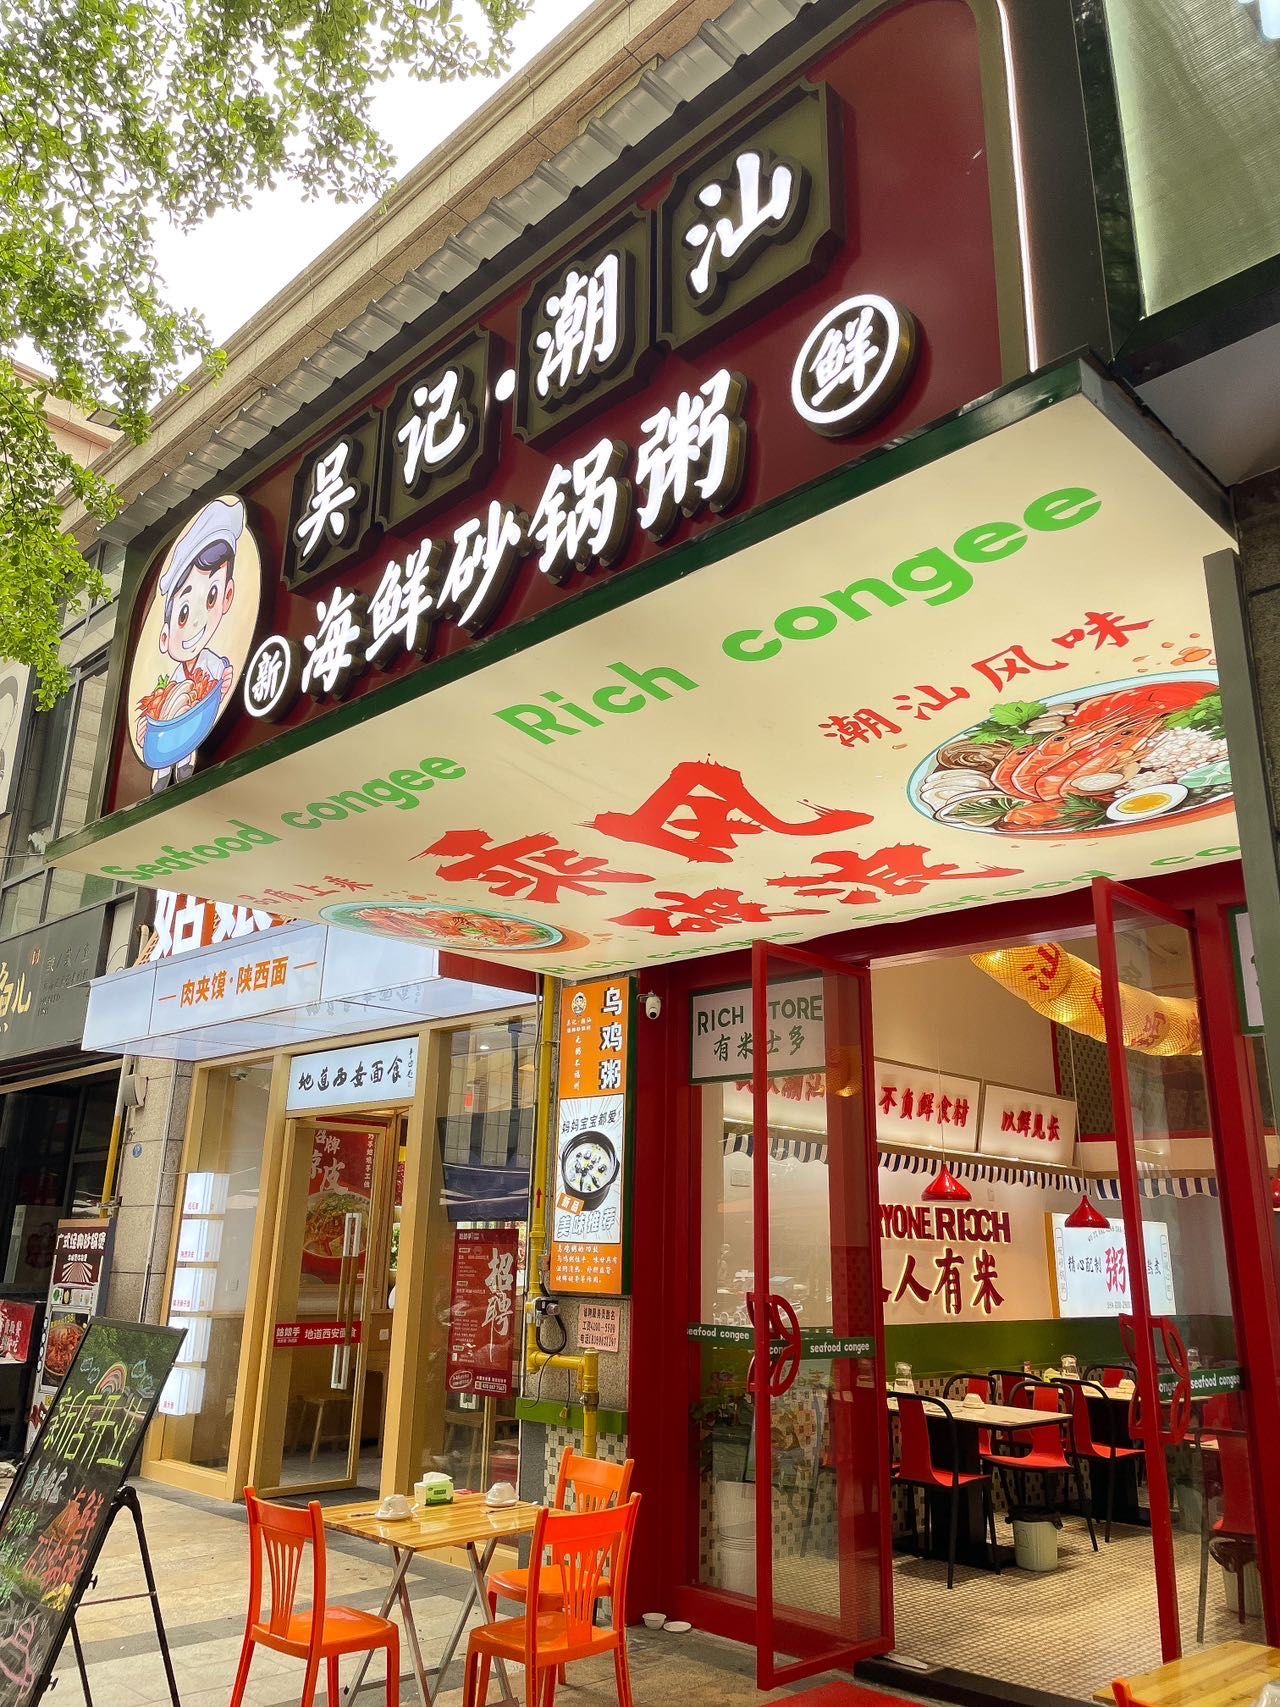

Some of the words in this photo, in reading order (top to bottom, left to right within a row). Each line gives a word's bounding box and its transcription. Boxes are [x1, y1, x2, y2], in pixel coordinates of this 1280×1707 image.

[301, 369, 731, 693] 海鲜砂锅粥
[493, 659, 699, 745] Rich
[722, 486, 1103, 663] congee
[818, 609, 1151, 750] 潮汕风味
[101, 819, 283, 881] Seafood
[280, 757, 467, 829] congee
[851, 869, 1117, 923] Seafood
[180, 955, 289, 1008] 肉夹馍·陕西面
[534, 958, 636, 976] Rich
[599, 986, 623, 1090] 乌鸡粥
[697, 1005, 744, 1037] RICH
[768, 994, 824, 1022] TORE
[713, 1024, 806, 1062] 有米士多
[298, 1055, 404, 1091] 地道西安面食
[1105, 1246, 1127, 1294] 粥
[482, 1247, 514, 1363] 招聘
[720, 1330, 750, 1342] congee
[810, 1342, 841, 1353] seafood
[844, 1342, 870, 1356] congee
[1190, 1373, 1217, 1389] seafood
[1219, 1374, 1241, 1389] congee
[43, 1386, 144, 1471] 新店开业
